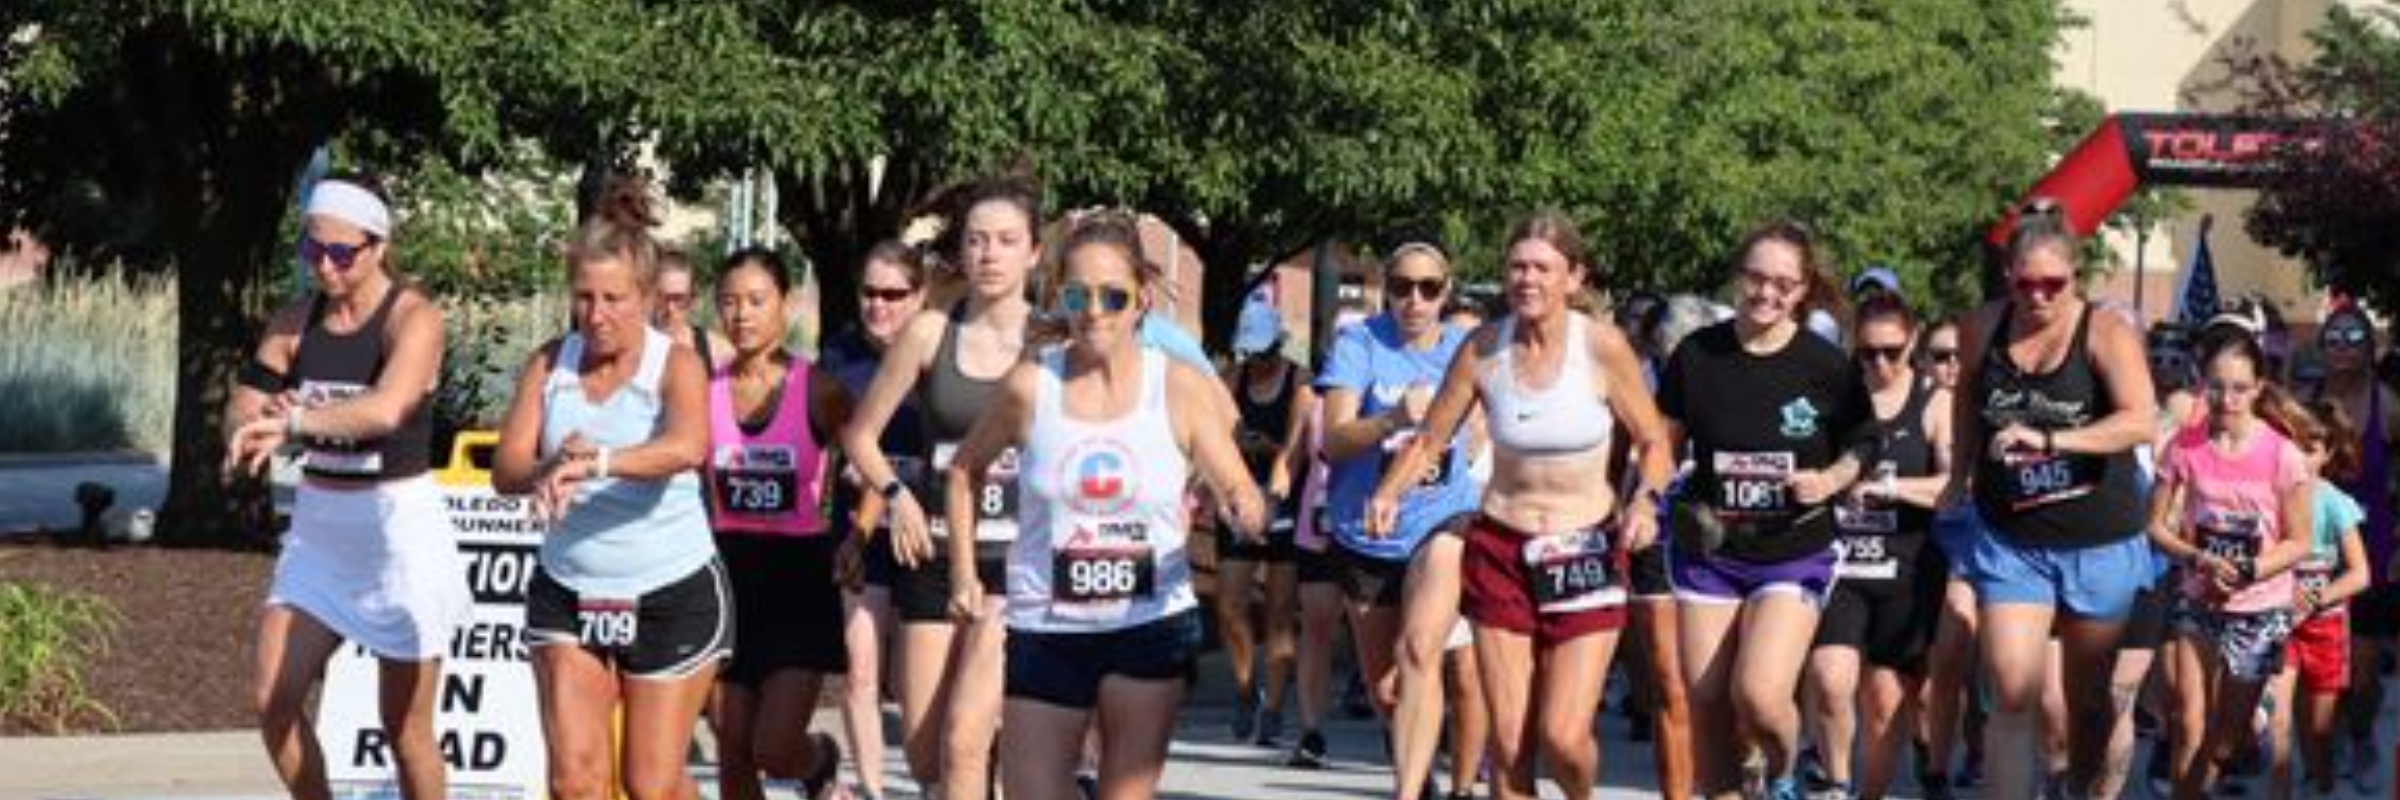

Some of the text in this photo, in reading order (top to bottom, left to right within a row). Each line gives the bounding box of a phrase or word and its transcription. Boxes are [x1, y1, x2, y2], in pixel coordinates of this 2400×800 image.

[728, 477, 783, 510] 739
[2021, 461, 2070, 495] 945
[1069, 560, 1135, 593] 986
[1546, 558, 1606, 595] 749
[578, 611, 637, 645] 709
[440, 673, 484, 713] N
[353, 728, 507, 771] RAD
